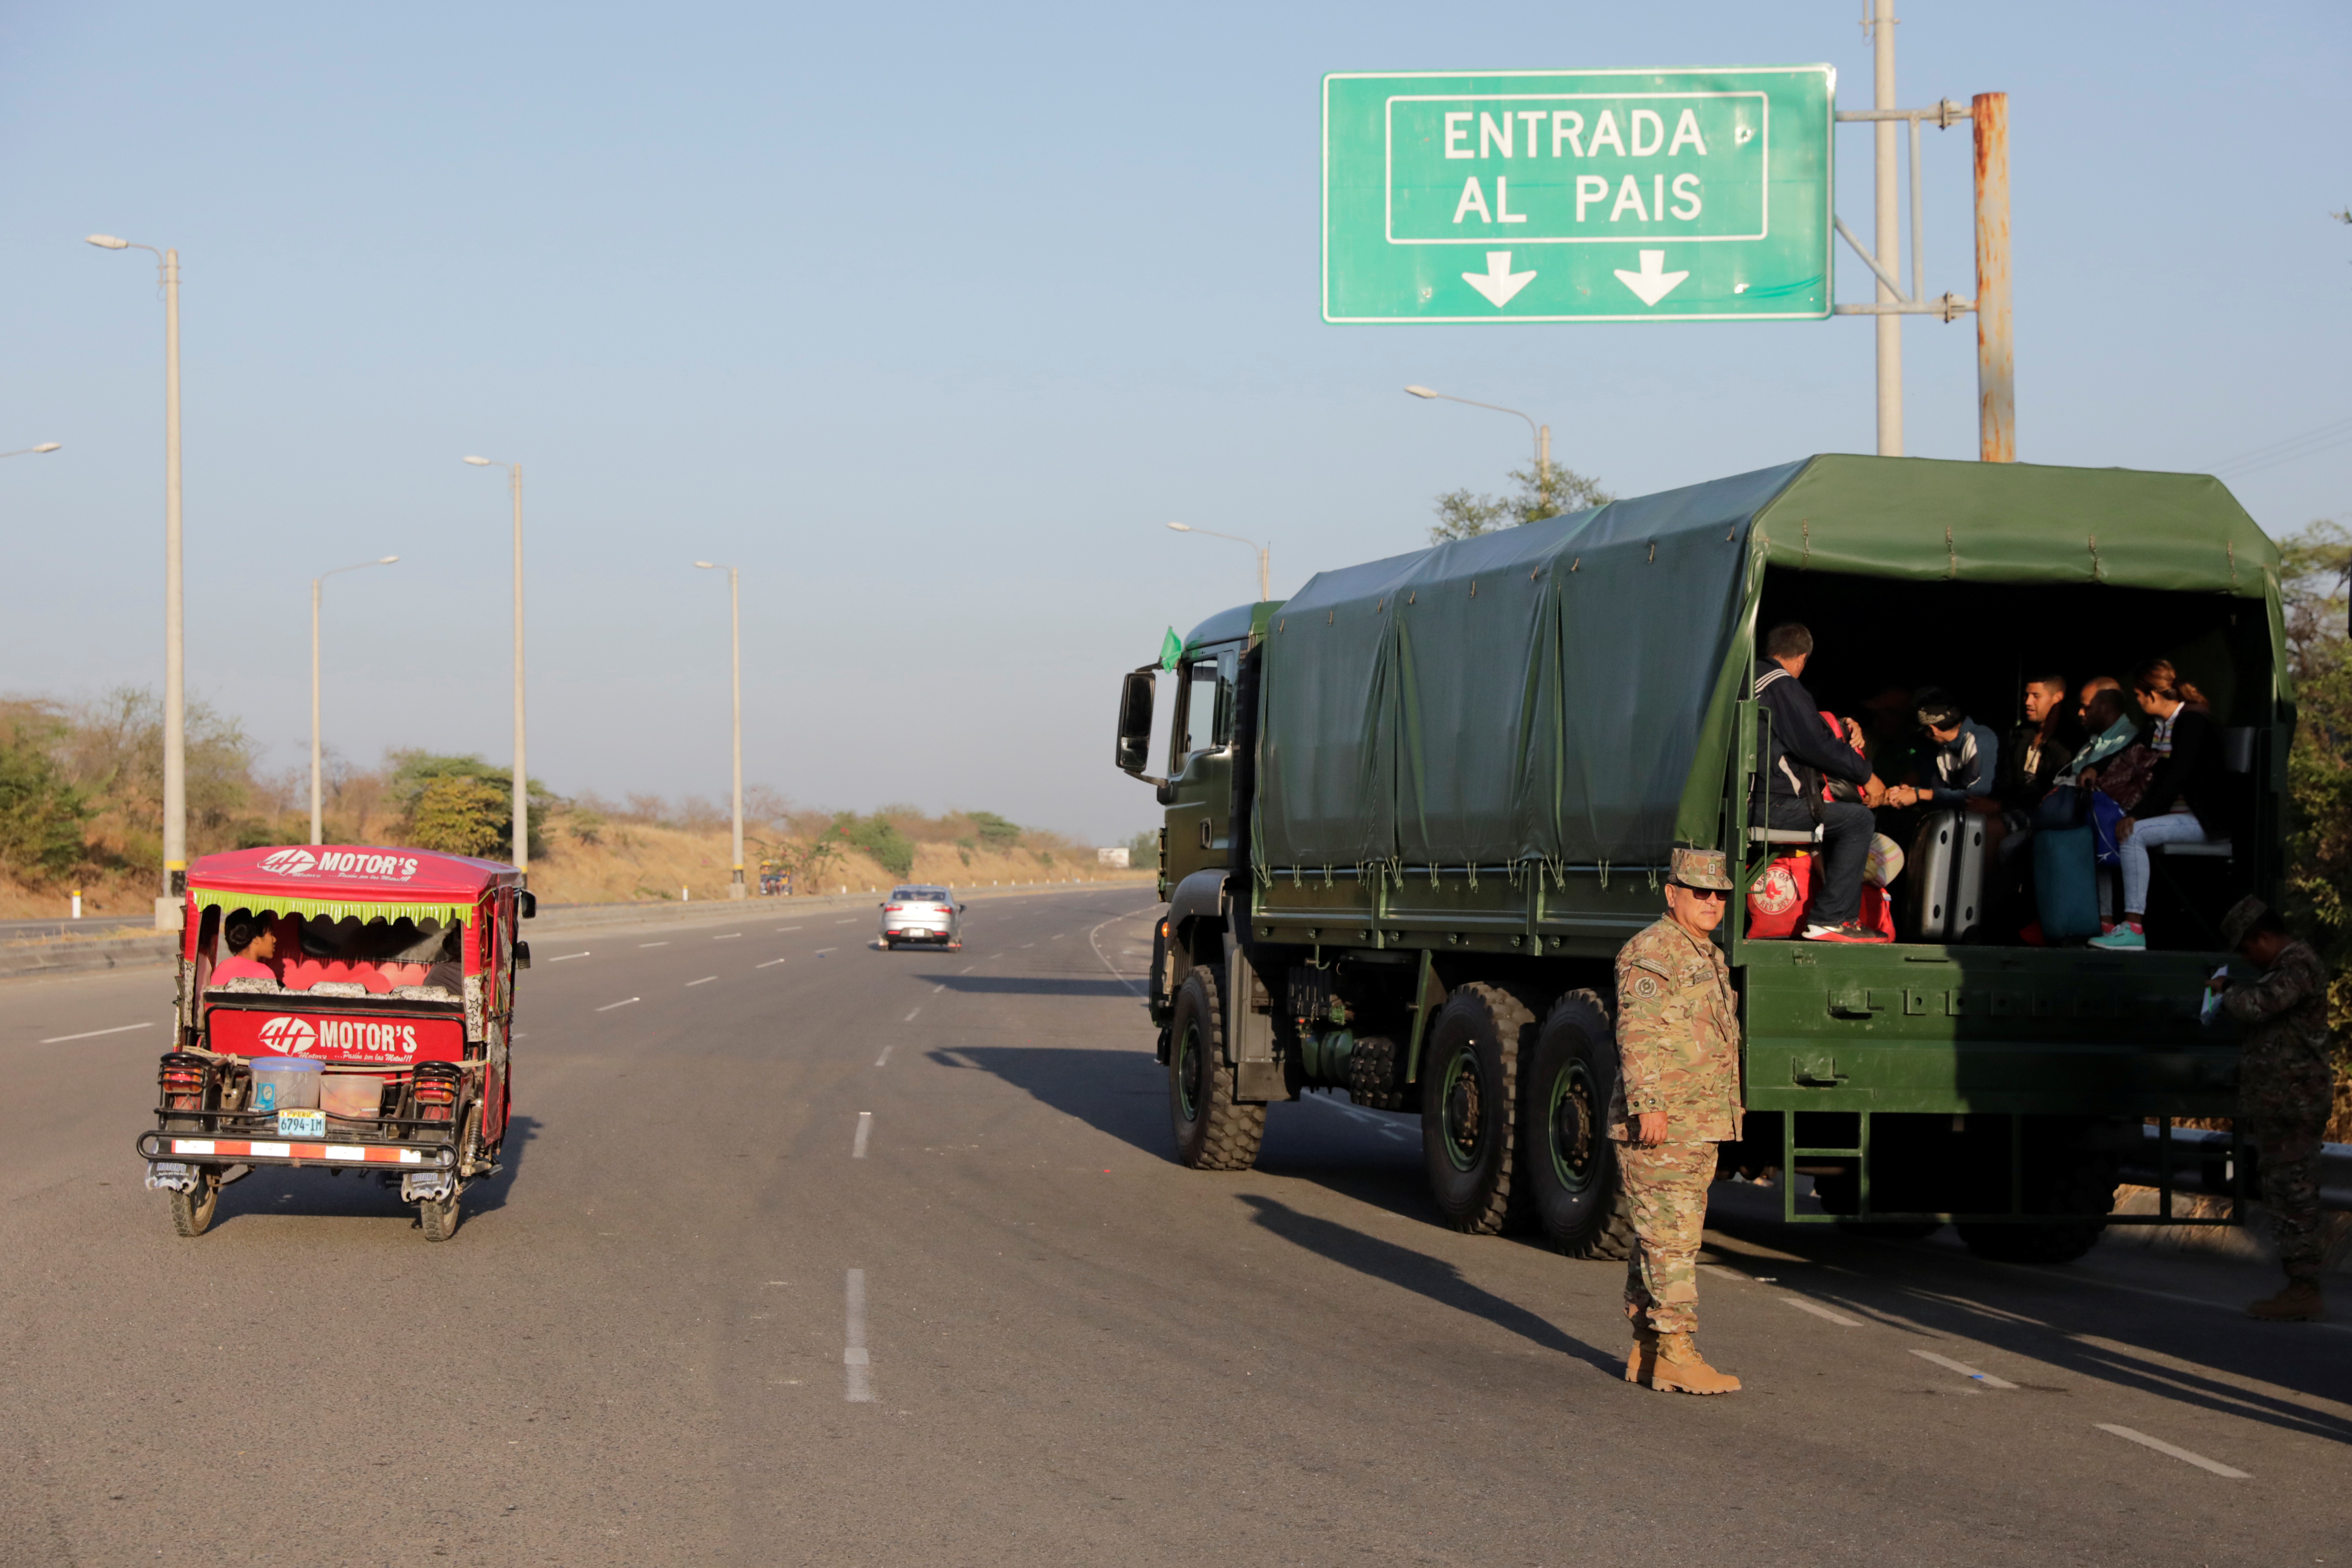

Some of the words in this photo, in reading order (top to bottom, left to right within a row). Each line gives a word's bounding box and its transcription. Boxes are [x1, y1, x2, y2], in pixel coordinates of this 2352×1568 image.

[1444, 109, 1708, 160] ENTRADA
[1452, 176, 1527, 224] AL
[1576, 174, 1703, 222] PAIS
[318, 852, 419, 875] MOTOR'S
[1756, 871, 1793, 886] BOSTON
[1760, 900, 1773, 911] RED
[1777, 896, 1792, 910] SOX
[319, 1020, 418, 1053] MOTOR'S
[281, 1118, 322, 1132] 6794-IM
